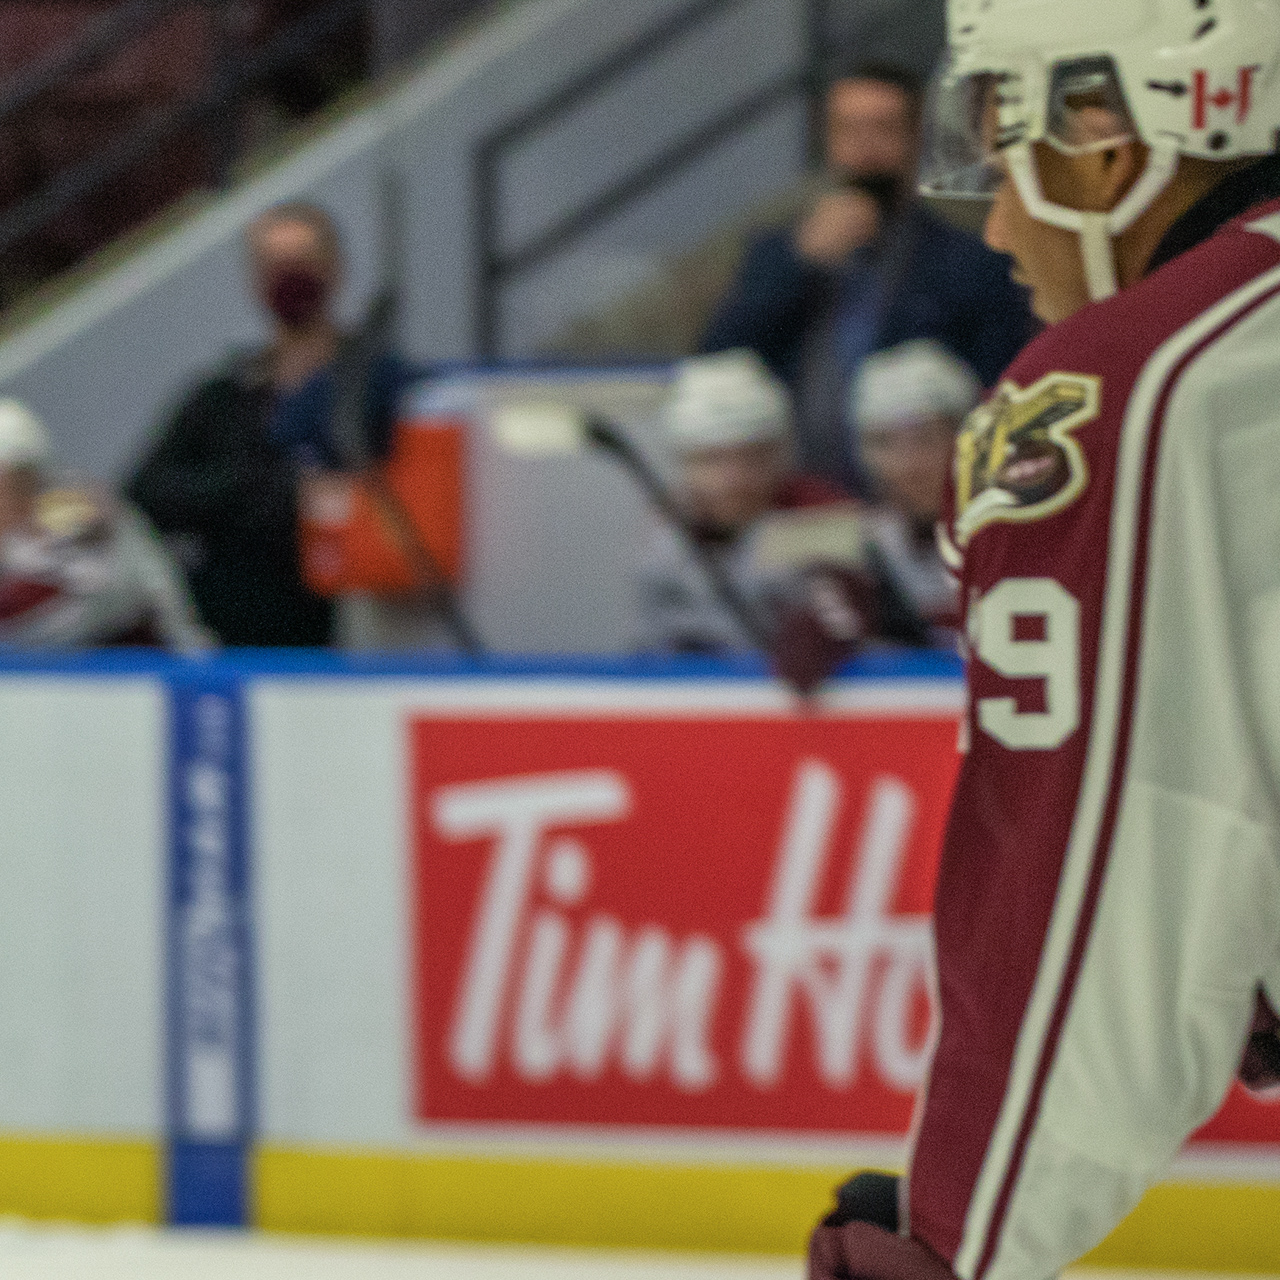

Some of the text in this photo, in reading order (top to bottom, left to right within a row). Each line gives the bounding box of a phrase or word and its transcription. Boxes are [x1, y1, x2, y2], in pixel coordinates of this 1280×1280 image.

[967, 576, 1081, 751] 9
[430, 766, 724, 1093] Tim
[738, 755, 939, 1093] Ho
